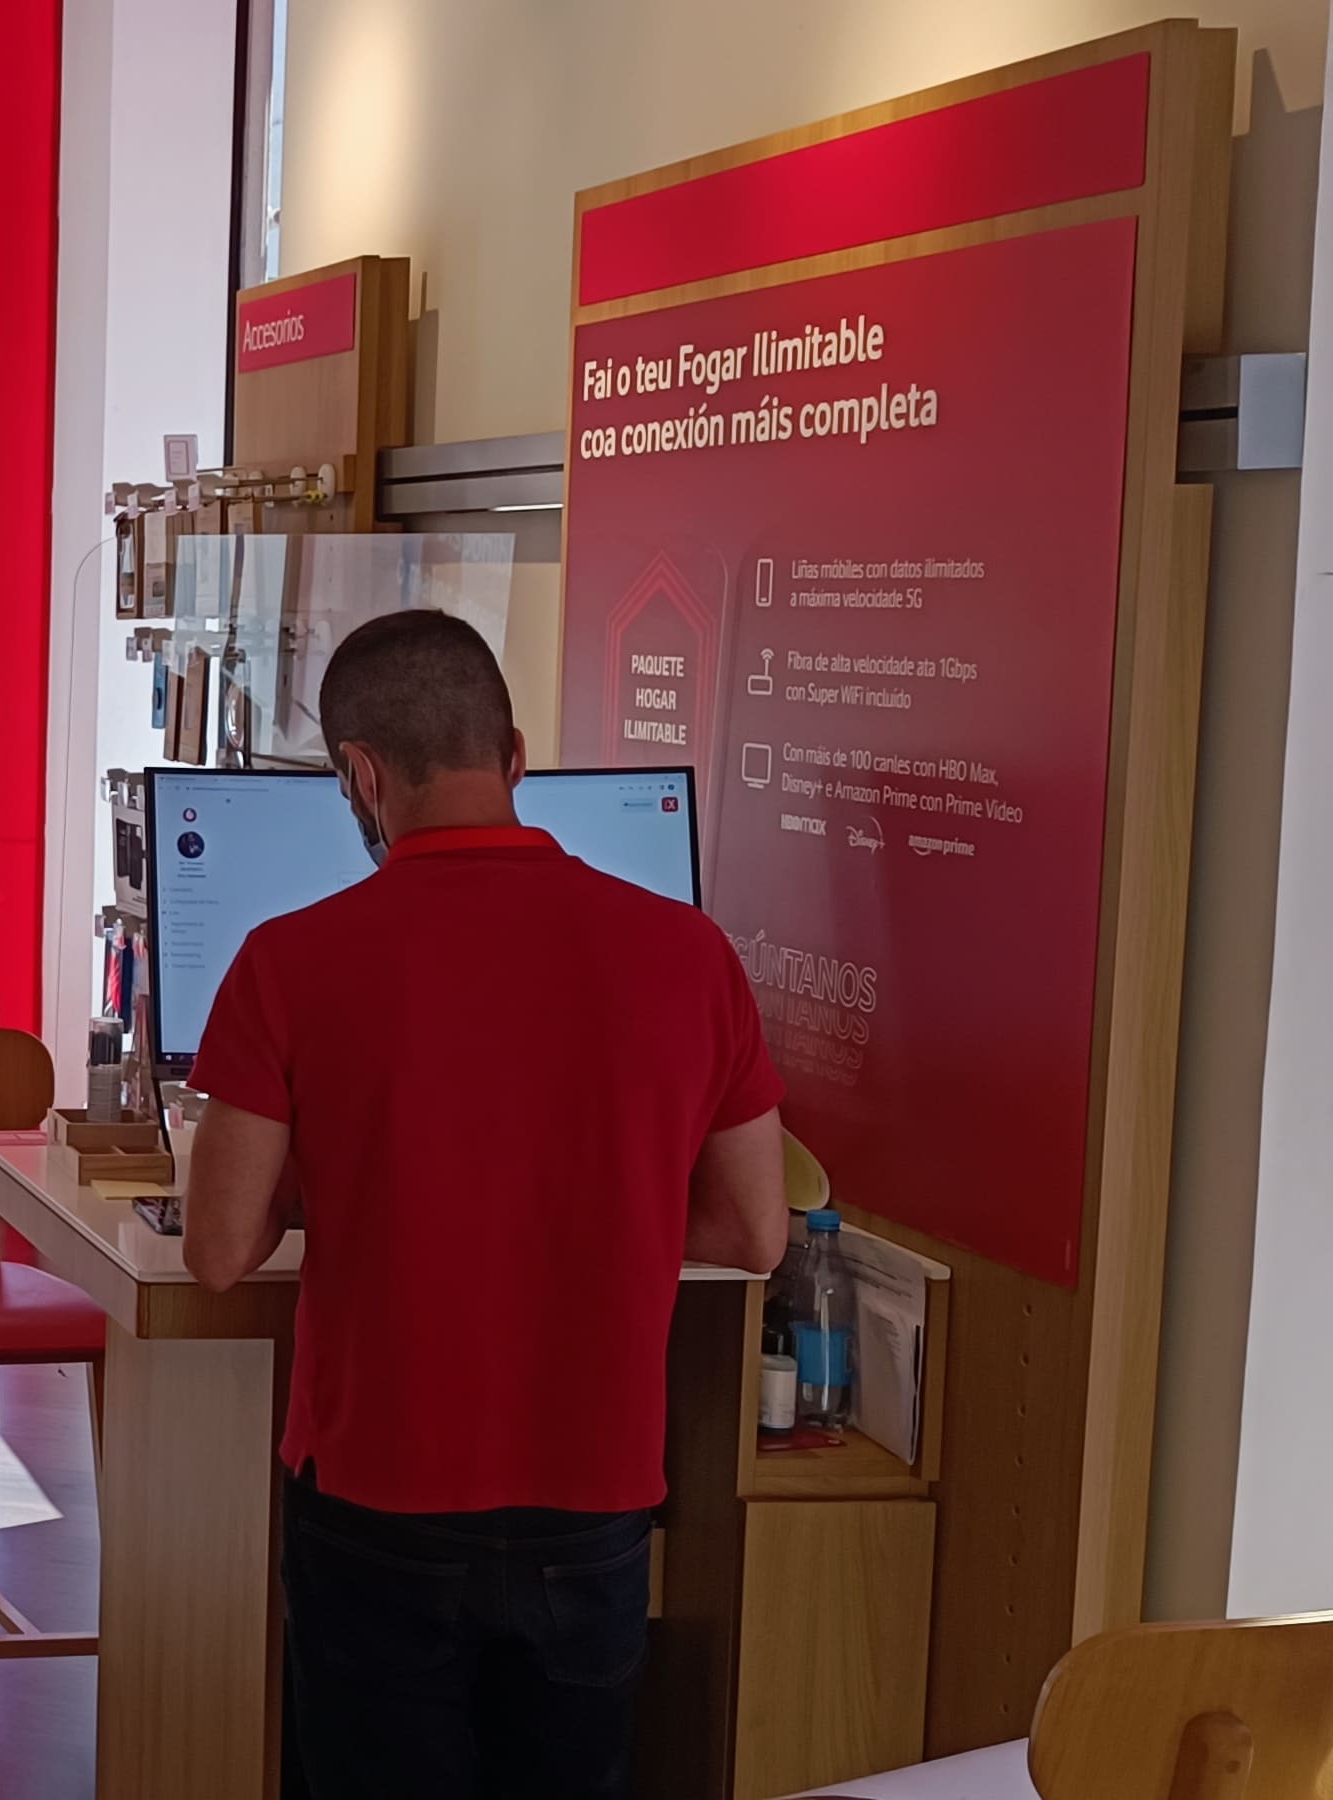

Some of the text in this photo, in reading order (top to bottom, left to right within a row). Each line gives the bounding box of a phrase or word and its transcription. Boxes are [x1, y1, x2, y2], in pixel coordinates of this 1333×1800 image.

[243, 309, 304, 352] Accesorios
[583, 314, 885, 401] Fai o teu Fogar Ilimitable
[580, 382, 938, 459] coa conexión máis completa
[792, 558, 985, 579] Liñas móbiles con datos ilimitados
[790, 587, 922, 609] a máxima velocidade 5G
[631, 655, 684, 677] PAQUETE
[787, 651, 977, 683] Fibra de alta velocidade ata 1Gbps
[635, 687, 677, 710] HOGAR
[786, 685, 806, 701] con
[808, 682, 839, 706] Super
[866, 687, 911, 709] incluído
[624, 719, 687, 745] ILIMITABLE
[782, 742, 999, 787] Con máis de 100 canles con HBO Max,
[782, 772, 823, 799] Disney+
[825, 784, 832, 798] e
[834, 780, 880, 804] Amazon
[883, 784, 917, 810] Prime
[920, 795, 943, 812] con
[945, 793, 982, 818] Prime
